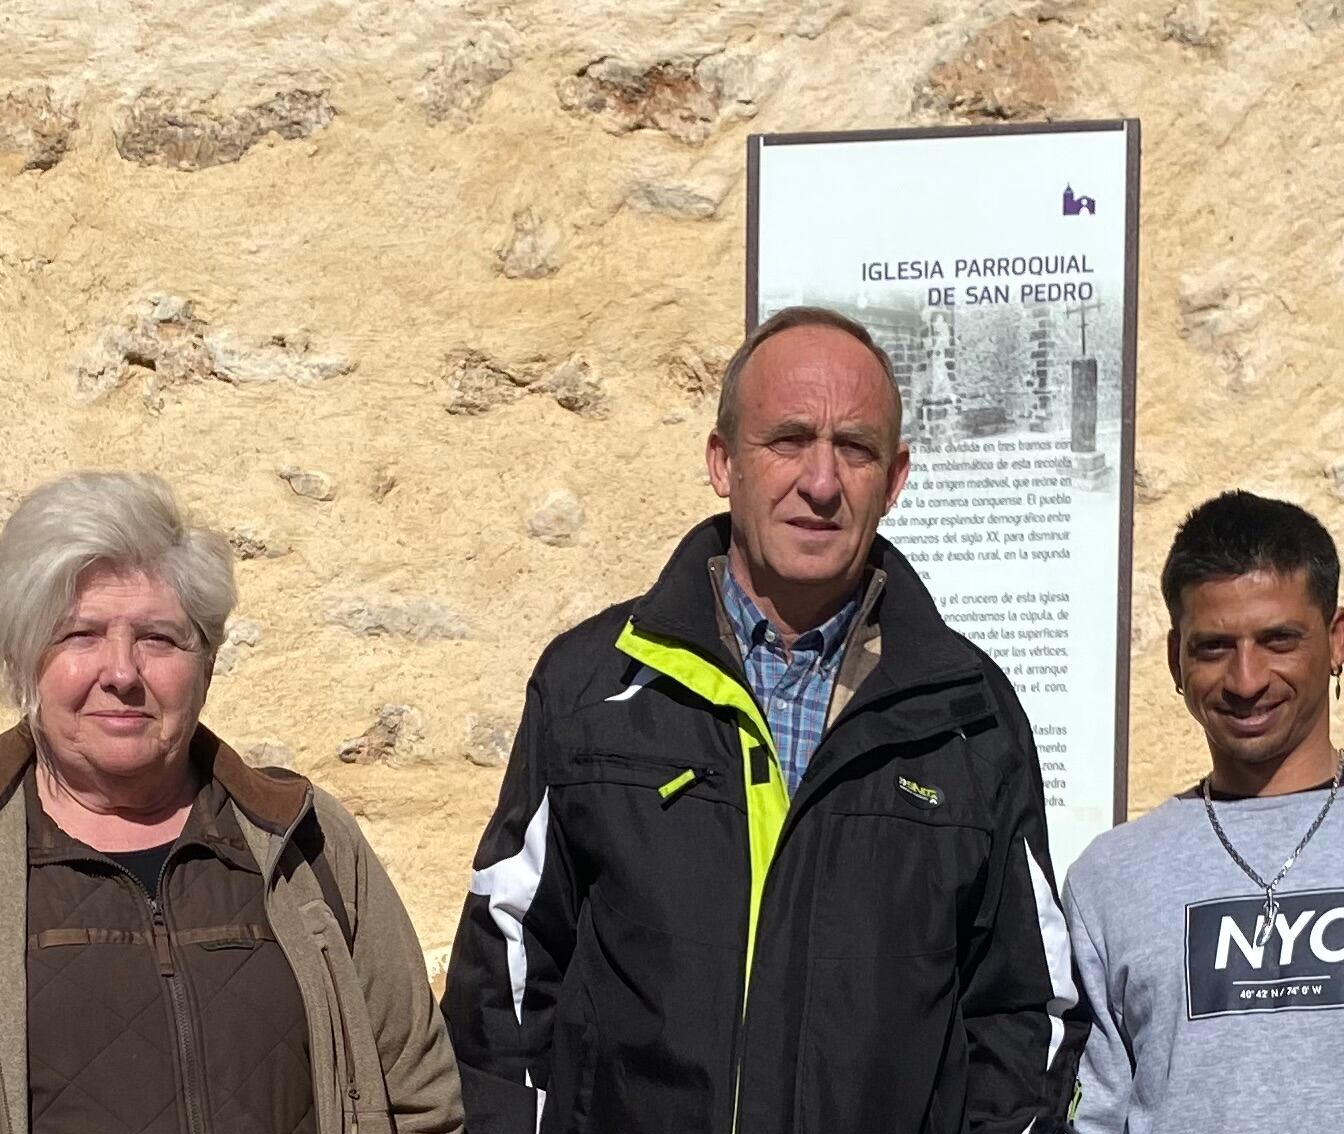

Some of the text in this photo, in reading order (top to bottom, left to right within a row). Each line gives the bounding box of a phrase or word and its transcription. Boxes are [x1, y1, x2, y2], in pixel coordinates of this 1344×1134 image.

[862, 254, 1094, 281] IGLESIA PARROQUIAL
[928, 281, 1093, 306] DE SAN PEDRO
[997, 458, 1008, 469] de
[923, 479, 934, 490] de
[901, 498, 912, 508] de
[916, 497, 925, 508] la
[1039, 493, 1072, 507] pueblo
[897, 514, 909, 526] de
[1047, 512, 1071, 523] entre
[961, 532, 983, 545] siglo
[1004, 533, 1024, 545] para
[933, 550, 944, 561] de
[1019, 548, 1028, 559] la
[1032, 548, 1070, 562] segunda
[940, 596, 946, 607] y
[950, 594, 958, 605] el
[962, 595, 998, 605] crucero
[1001, 593, 1013, 604] de
[1016, 592, 1036, 604] esta
[1039, 591, 1070, 606] iglesia
[944, 612, 1005, 622] encontramos
[1008, 611, 1017, 621] la
[1057, 609, 1069, 621] de
[969, 632, 985, 640] una
[987, 628, 999, 640] de
[1001, 628, 1015, 640] las
[994, 648, 1009, 659] por
[1012, 646, 1026, 657] los
[1014, 663, 1023, 675] el
[1026, 665, 1068, 677] arranque
[1031, 681, 1040, 693] el
[1271, 989, 1279, 998] N
[1312, 985, 1322, 994] W
